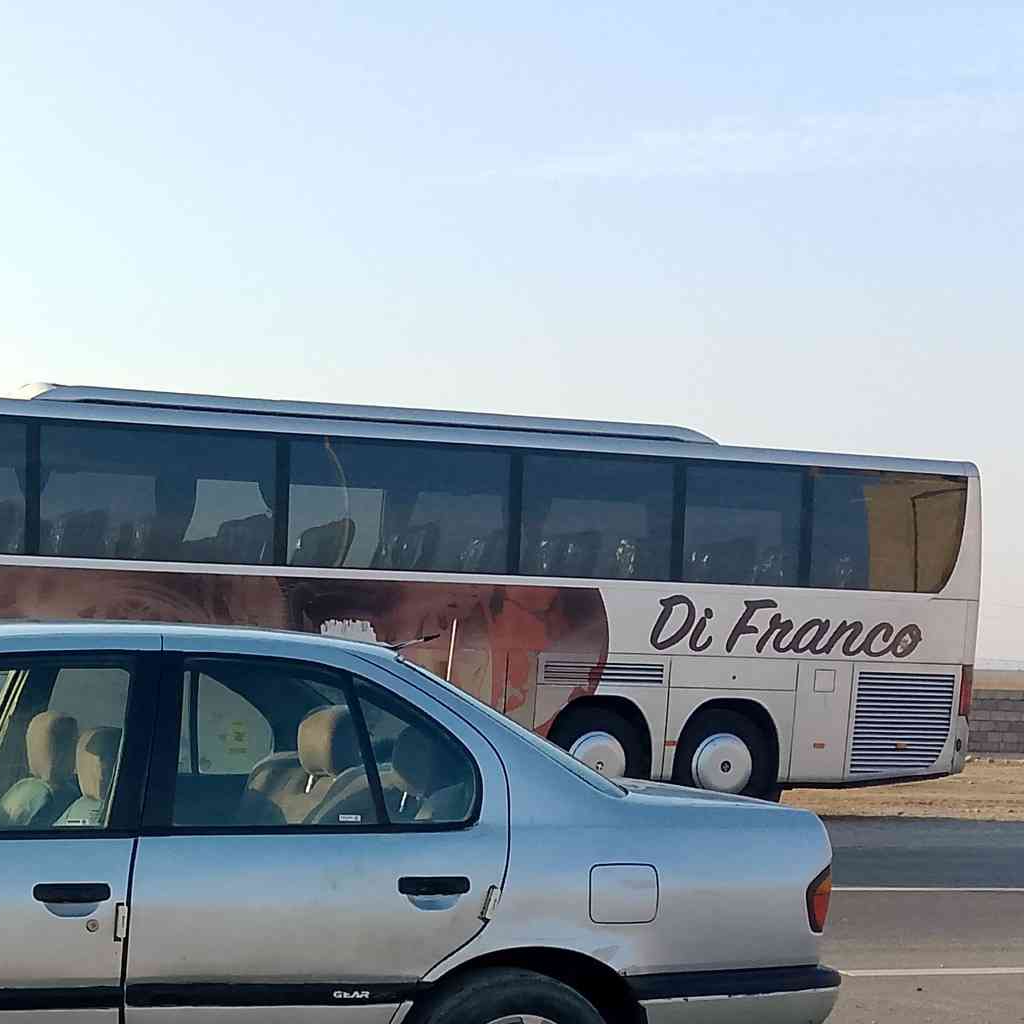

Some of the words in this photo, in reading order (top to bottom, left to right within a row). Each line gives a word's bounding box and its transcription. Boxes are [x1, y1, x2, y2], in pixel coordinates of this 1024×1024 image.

[650, 594, 714, 652] Di
[725, 598, 923, 659] Franco
[332, 990, 370, 999] GEAR
